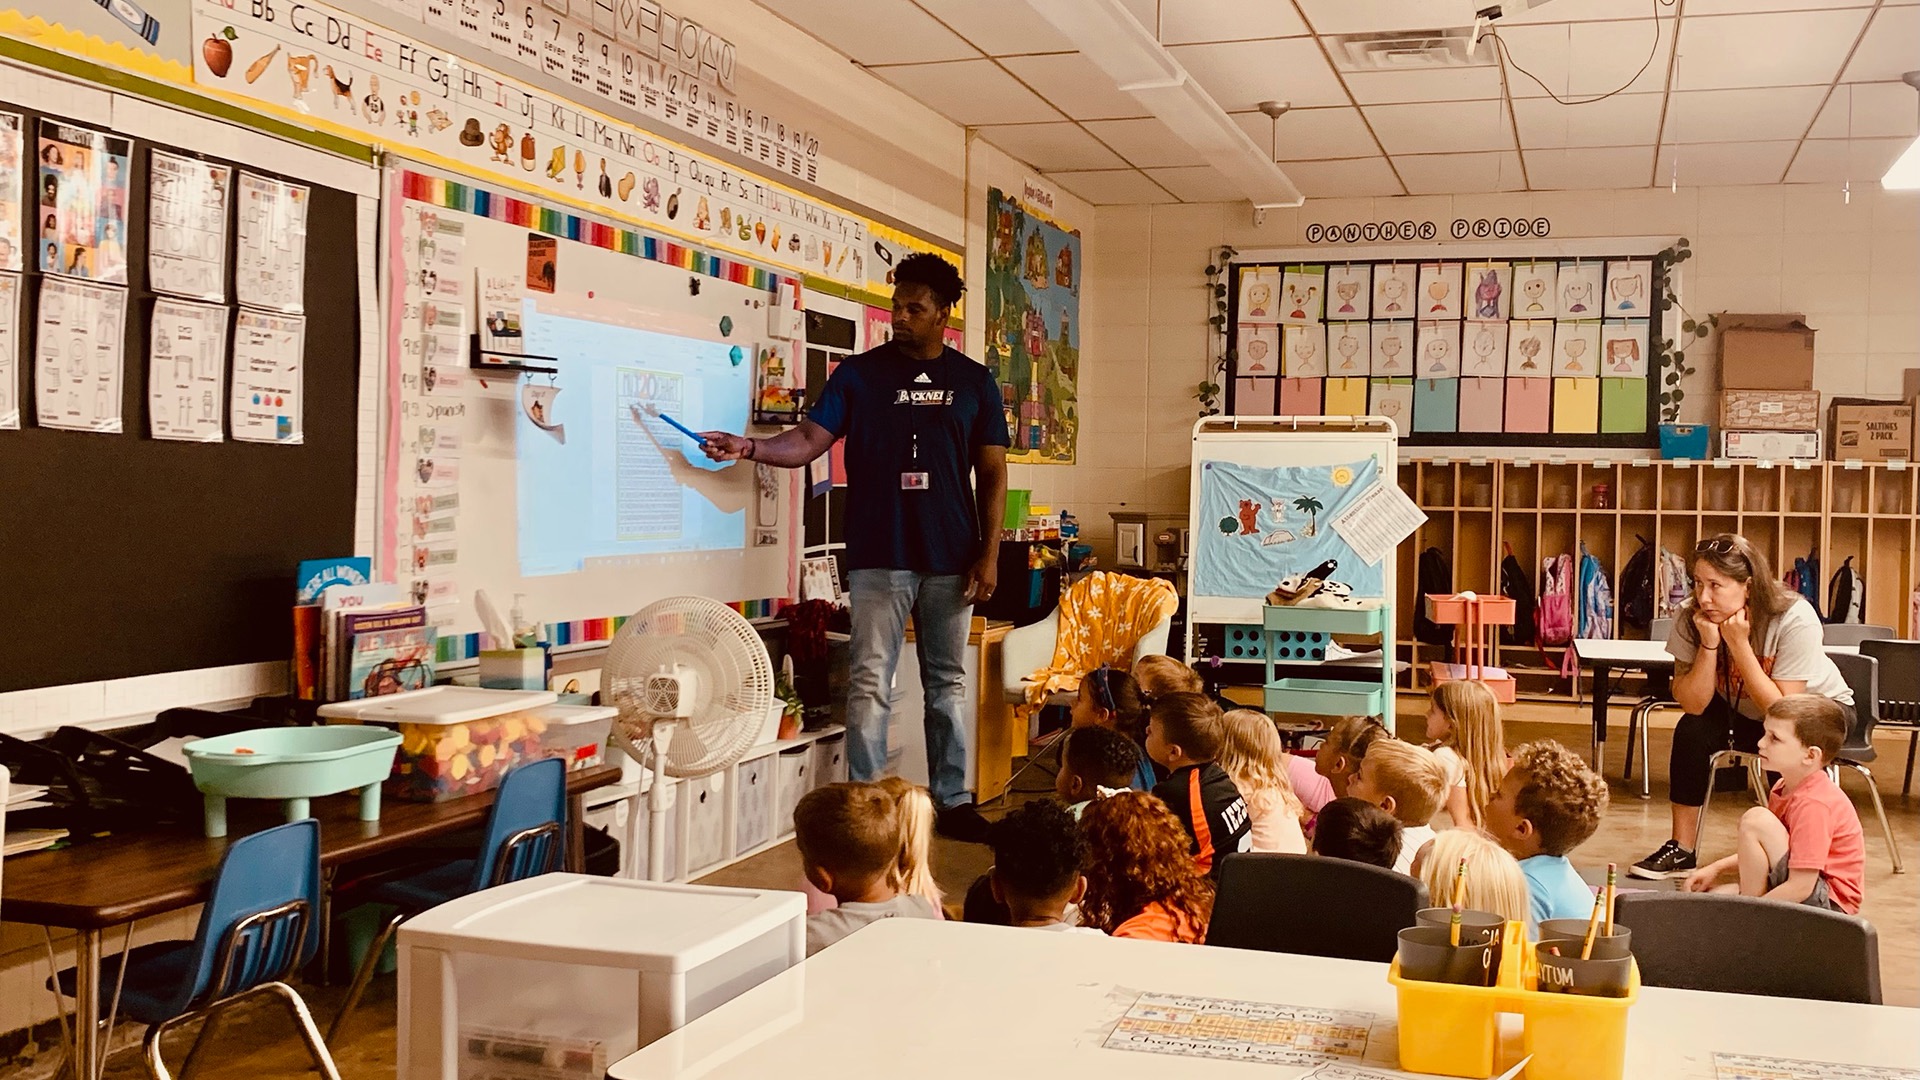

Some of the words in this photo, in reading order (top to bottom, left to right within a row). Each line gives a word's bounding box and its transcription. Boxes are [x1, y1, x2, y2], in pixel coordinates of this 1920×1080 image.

[492, 11, 510, 30] five
[495, 0, 505, 17] 5
[525, 6, 534, 29] 6
[552, 19, 561, 41] 7
[577, 32, 585, 54] 8
[601, 44, 609, 65] 9
[621, 52, 634, 76] 10
[647, 64, 654, 85] 11
[667, 74, 678, 95] 12
[688, 83, 699, 105] 13
[707, 92, 717, 113] 14
[725, 101, 735, 122] 15
[744, 108, 753, 128] 16
[761, 115, 769, 133] 17
[777, 123, 785, 142] 18
[793, 131, 801, 150] 19
[806, 138, 819, 157] 20
[252, 0, 275, 22] Bb
[291, 5, 313, 37] Cc
[328, 17, 350, 50] Dd
[365, 31, 383, 62] Ee
[400, 44, 417, 74] Ff
[427, 56, 449, 98] Gg
[463, 68, 482, 99] Hh
[521, 92, 534, 129] Jj
[552, 103, 566, 131] Kk
[594, 121, 614, 150] Mm
[619, 132, 636, 157] Nn
[643, 141, 660, 166] Oo
[668, 150, 680, 183] Pp
[721, 171, 731, 192] Rr
[739, 178, 748, 200] Ss
[755, 184, 764, 205] Tt
[789, 198, 799, 217] Vv
[805, 203, 818, 224] Ww
[822, 209, 831, 230] Xx
[837, 216, 848, 243] Yy
[853, 222, 862, 241] Zz
[1307, 221, 1436, 243] PANTHER
[1451, 217, 1550, 239] PRIDE
[426, 402, 466, 420] Spanish
[1866, 422, 1898, 431] SALTINES
[1870, 432, 1875, 440] 2
[1876, 432, 1893, 440] PACK
[1341, 501, 1366, 525] Attention
[339, 596, 364, 607] YOU
[1175, 1001, 1296, 1020] Washington
[1302, 1013, 1334, 1022] Gia
[1130, 1035, 1239, 1052] Champion
[1246, 1046, 1339, 1060] Lorenzo
